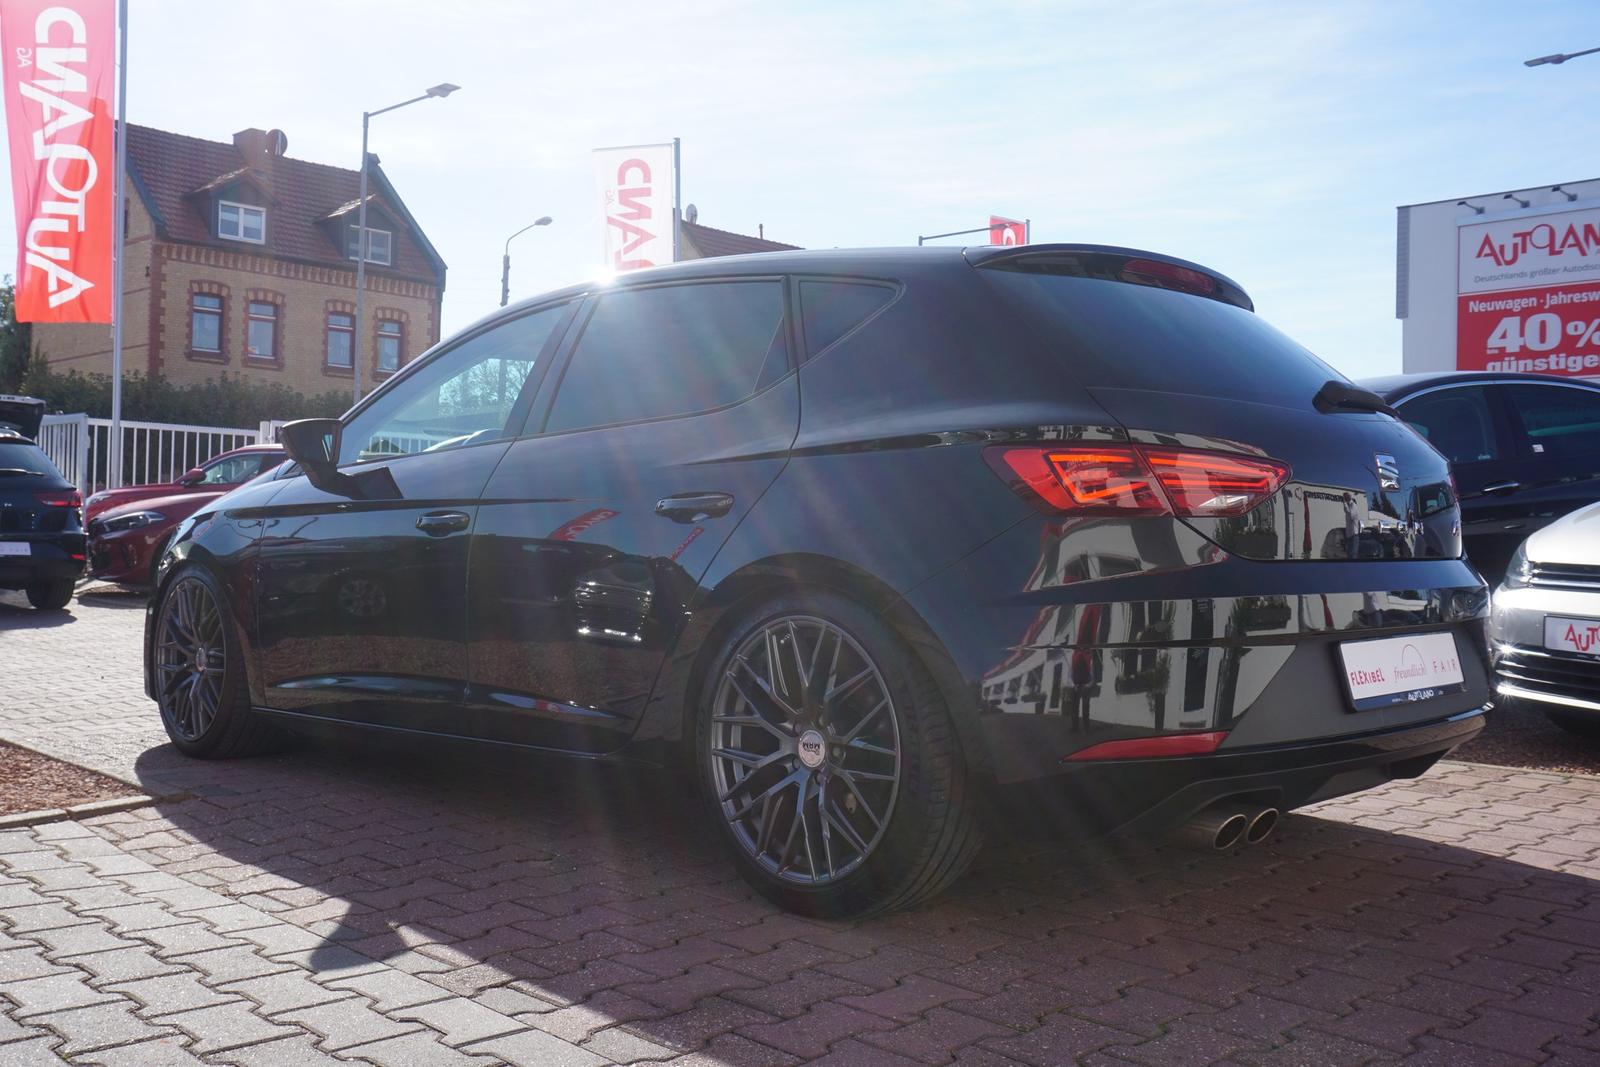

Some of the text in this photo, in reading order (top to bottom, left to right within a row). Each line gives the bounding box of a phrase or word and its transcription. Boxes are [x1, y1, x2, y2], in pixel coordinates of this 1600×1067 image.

[1474, 269, 1528, 283] Deutschlands
[1469, 297, 1537, 313] Neuwagen
[1350, 659, 1458, 686] FLEXIBEL freundlich FAIR
